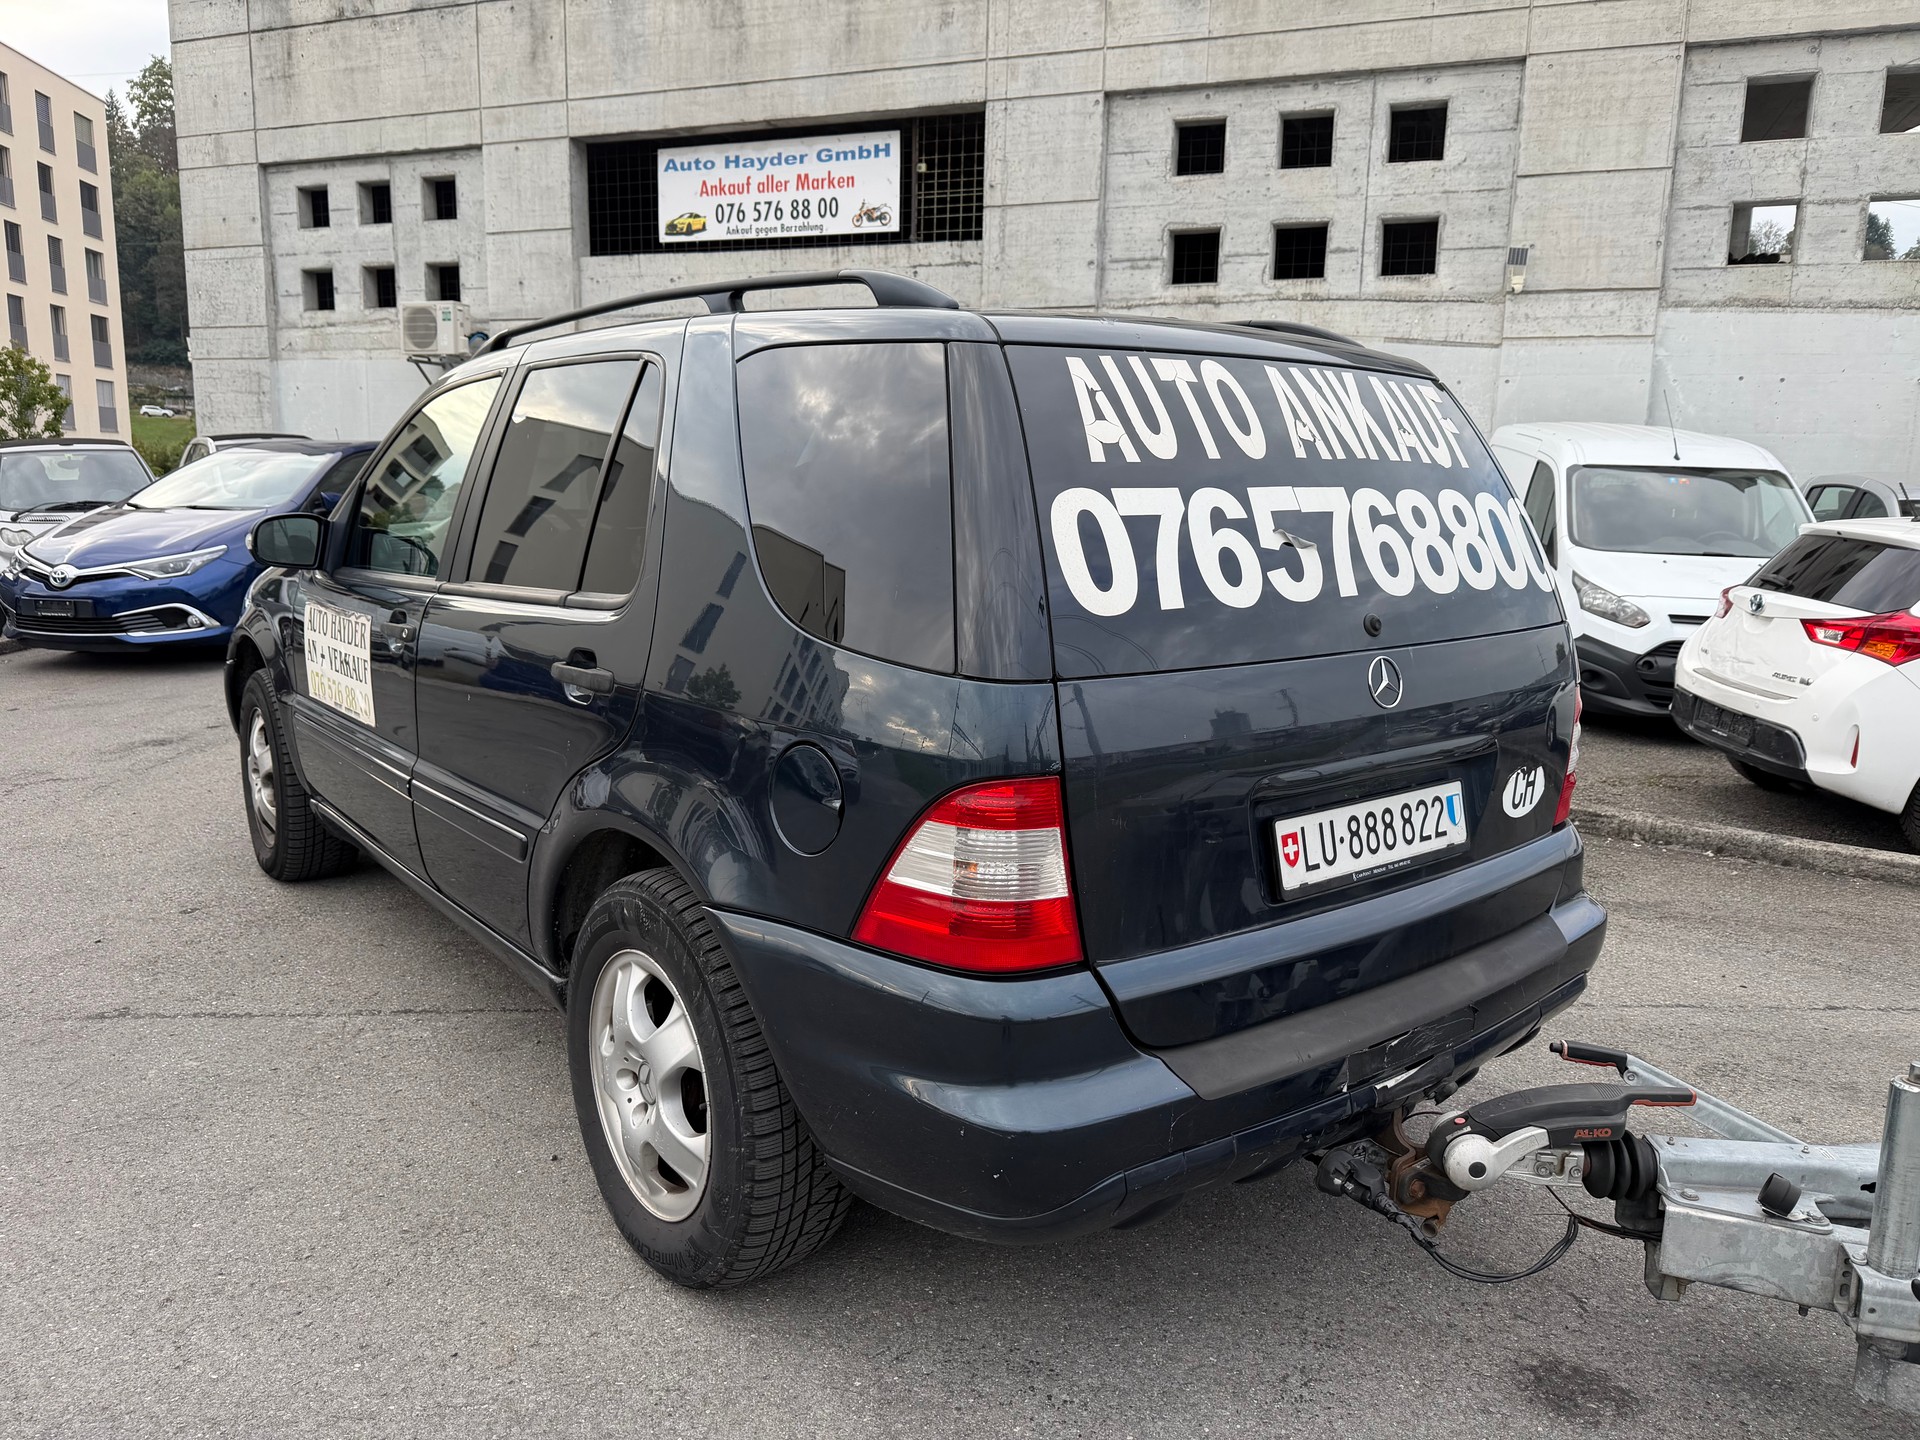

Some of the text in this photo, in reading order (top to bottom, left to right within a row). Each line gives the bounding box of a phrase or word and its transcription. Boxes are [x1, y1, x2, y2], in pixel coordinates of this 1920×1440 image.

[663, 143, 891, 172] Auto Hayder GmbH
[699, 170, 855, 197] Ankauf aller Marken
[715, 196, 839, 224] 076 576 88 00
[726, 222, 824, 236] Ankauf gegen Barzahlung
[1065, 355, 1470, 469] AUTO ANKAUF
[1050, 486, 1555, 617] 0765768800
[307, 607, 367, 650] AUTO HAYDER
[327, 646, 369, 684] VERKAUF
[311, 670, 326, 697] 076
[327, 677, 343, 704] 576
[345, 685, 357, 711] 88
[1511, 768, 1537, 810] CH
[1573, 1127, 1612, 1139] AL-KO
